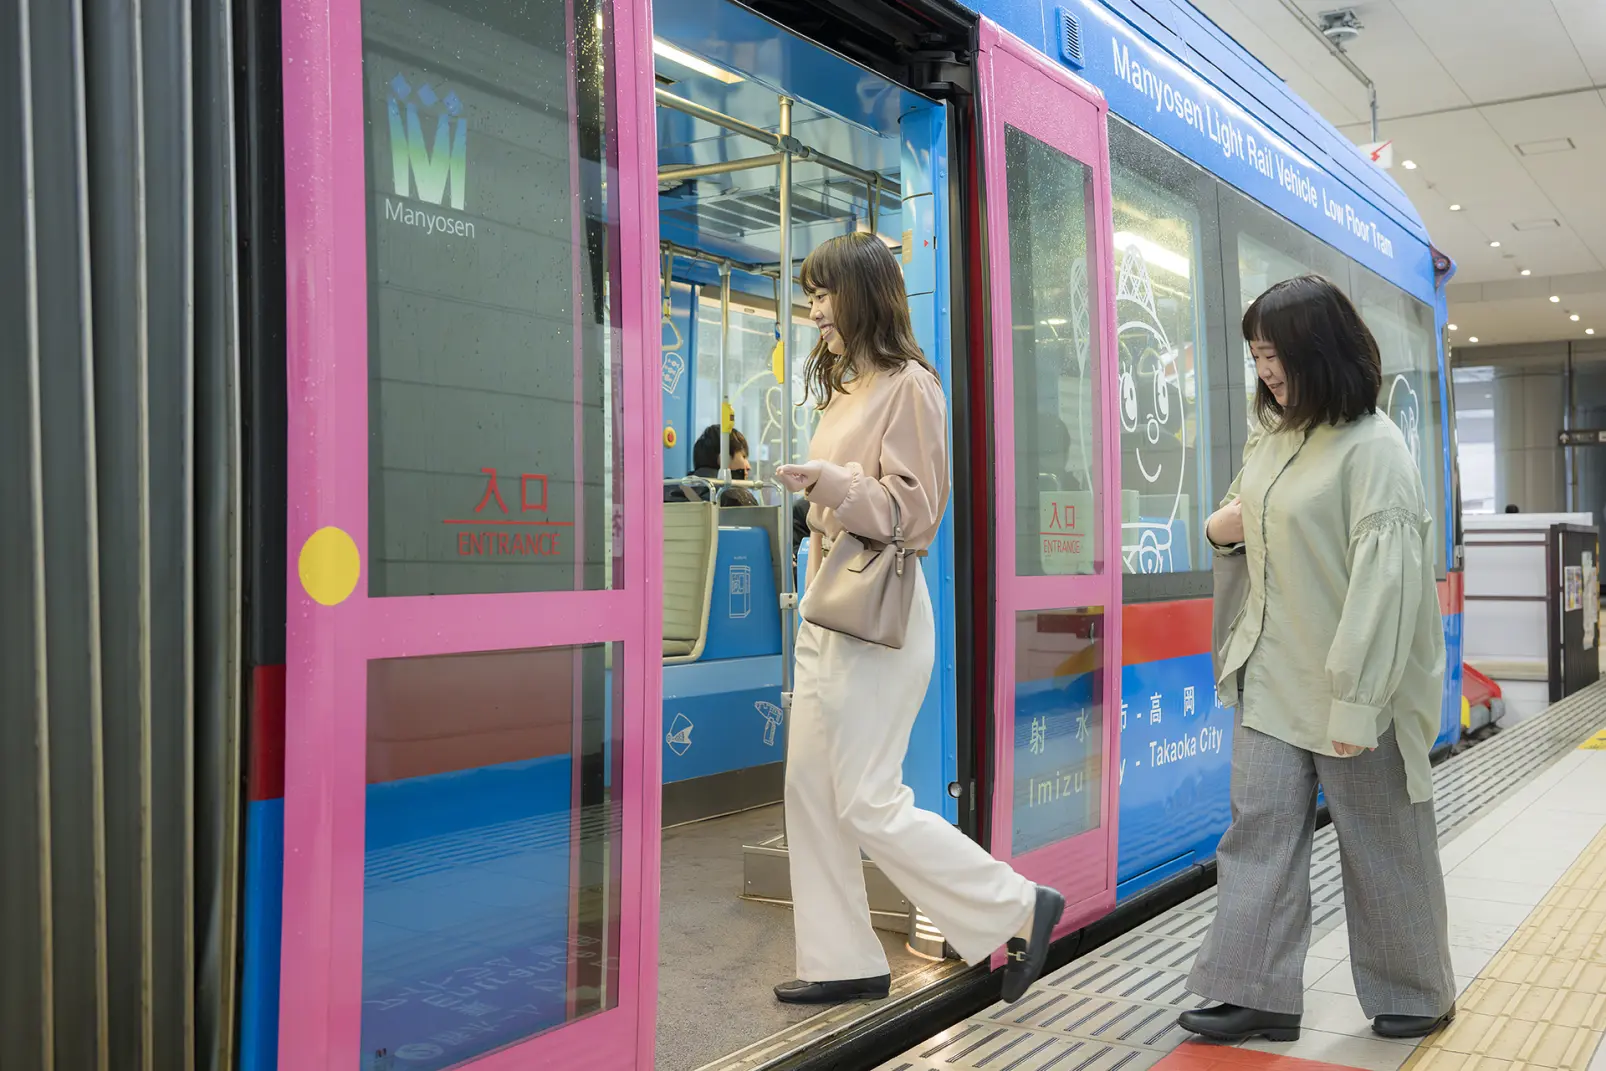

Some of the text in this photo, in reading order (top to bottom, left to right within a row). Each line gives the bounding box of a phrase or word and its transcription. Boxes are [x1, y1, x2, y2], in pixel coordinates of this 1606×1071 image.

[1112, 37, 1394, 259] Manyosen Light Rail Vehicle Low Floor Tram
[385, 198, 475, 239] Manyosen
[474, 467, 548, 514] 入口
[1049, 502, 1076, 529] 入口
[458, 531, 561, 556] ENTRANCE
[1043, 539, 1081, 554] ENTRANCE
[1029, 771, 1083, 808] Imizu
[1150, 733, 1197, 768] Takaoka
[1200, 726, 1223, 754] City
